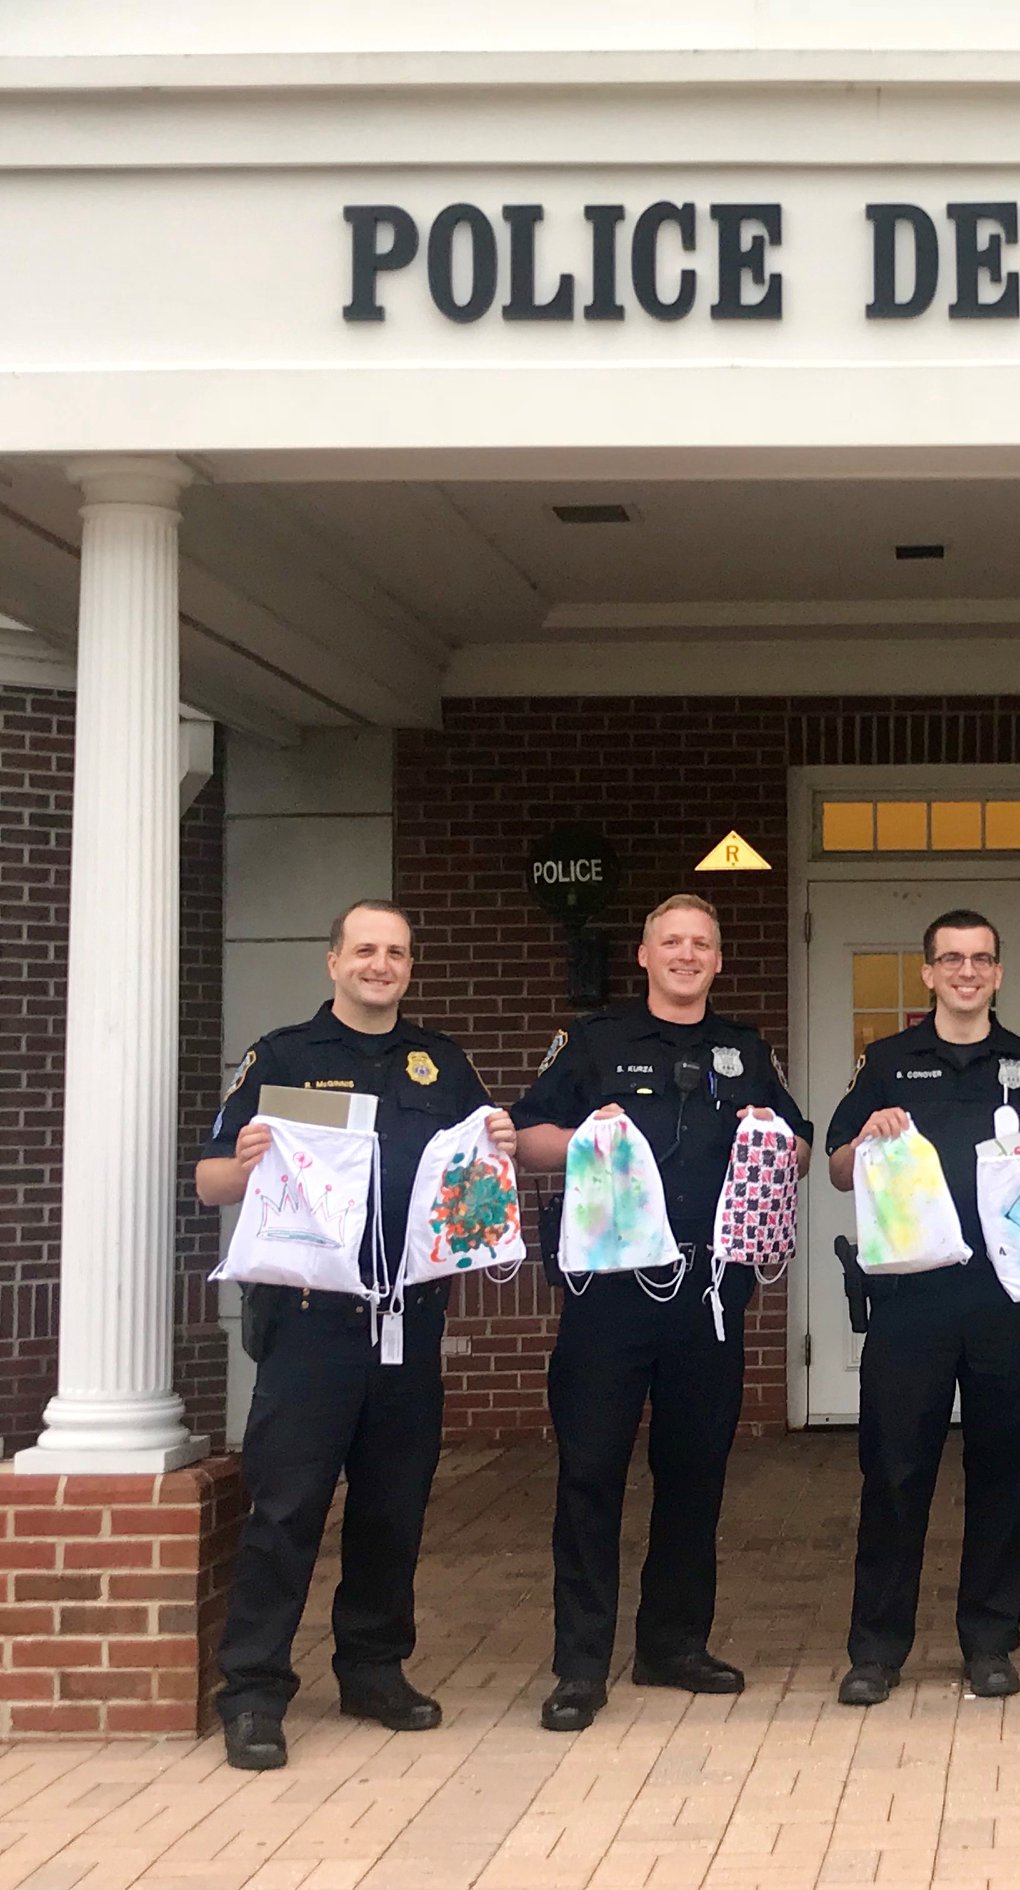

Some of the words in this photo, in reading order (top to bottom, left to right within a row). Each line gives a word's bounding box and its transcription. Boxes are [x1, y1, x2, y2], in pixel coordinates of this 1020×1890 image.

[342, 200, 783, 324] POLICE
[725, 845, 739, 862] R
[533, 858, 603, 884] POLICE
[907, 1069, 943, 1079] CONOVER
